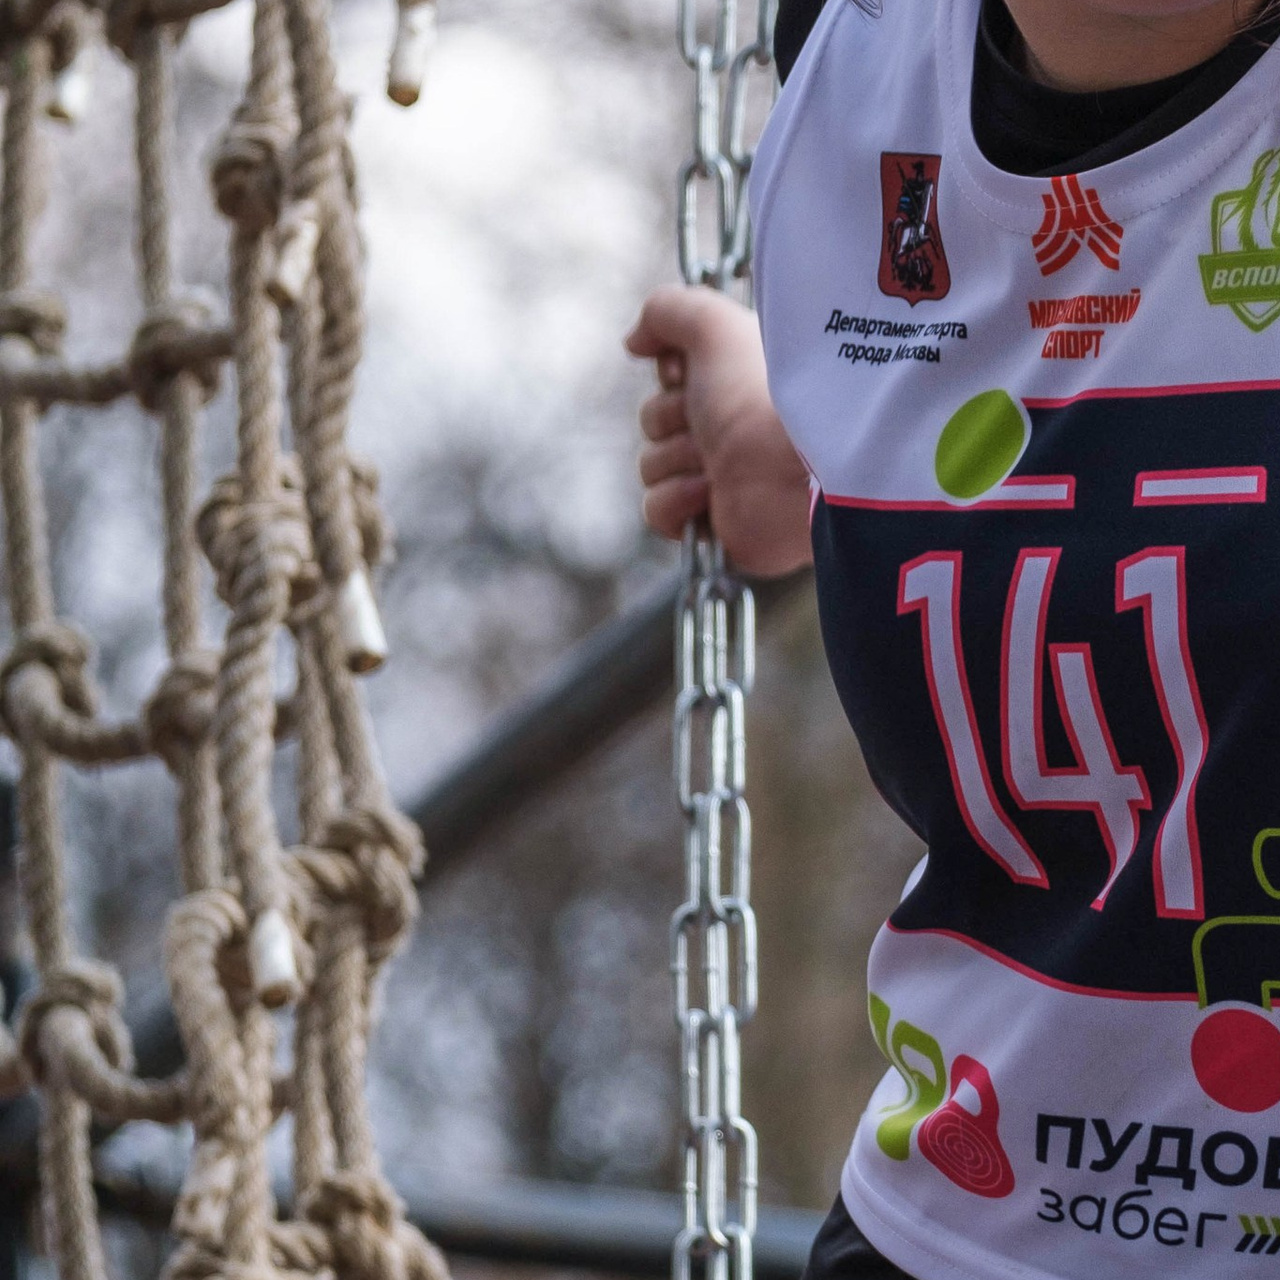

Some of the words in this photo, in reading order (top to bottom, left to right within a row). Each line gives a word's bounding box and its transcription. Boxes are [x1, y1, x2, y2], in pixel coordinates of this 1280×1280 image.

[824, 309, 925, 339] Департамент
[838, 342, 893, 366] города
[1041, 330, 1105, 358] СПОРТ
[897, 546, 1208, 920] 141
[1036, 1187, 1227, 1249] забег
